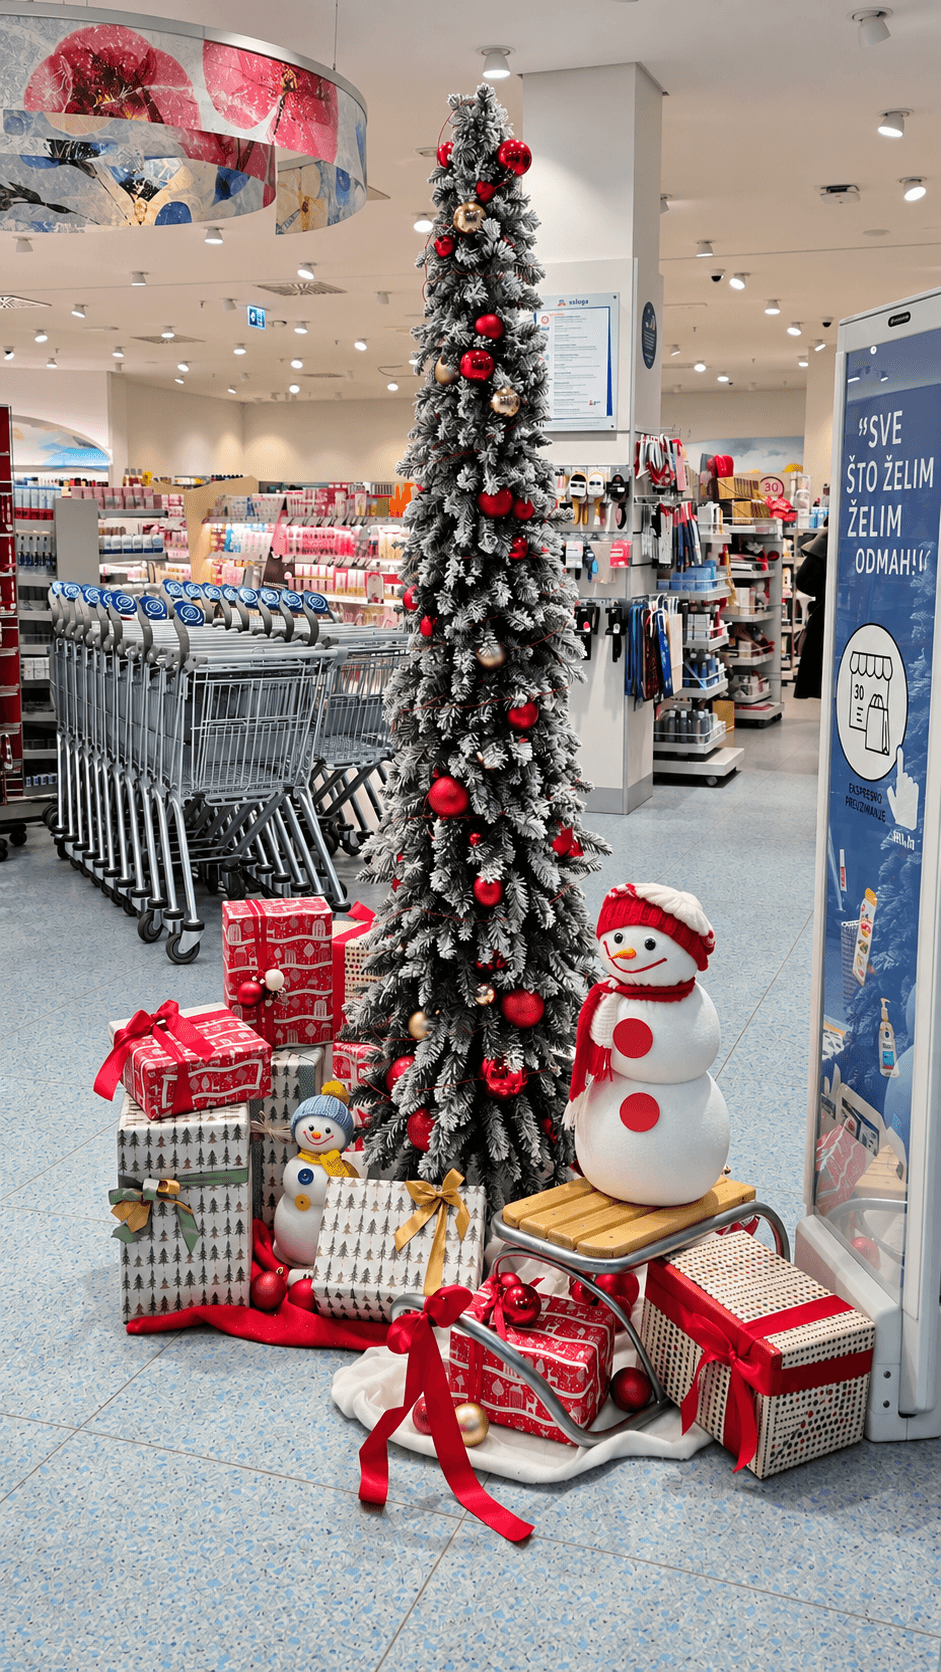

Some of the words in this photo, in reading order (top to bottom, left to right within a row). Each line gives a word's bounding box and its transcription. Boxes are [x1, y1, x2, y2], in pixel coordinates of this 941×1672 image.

[764, 482, 778, 492] 30
[846, 454, 878, 494] ŠTO
[883, 454, 935, 491] ŽELIM
[847, 499, 902, 537] ŽELIM
[854, 683, 864, 700] 30
